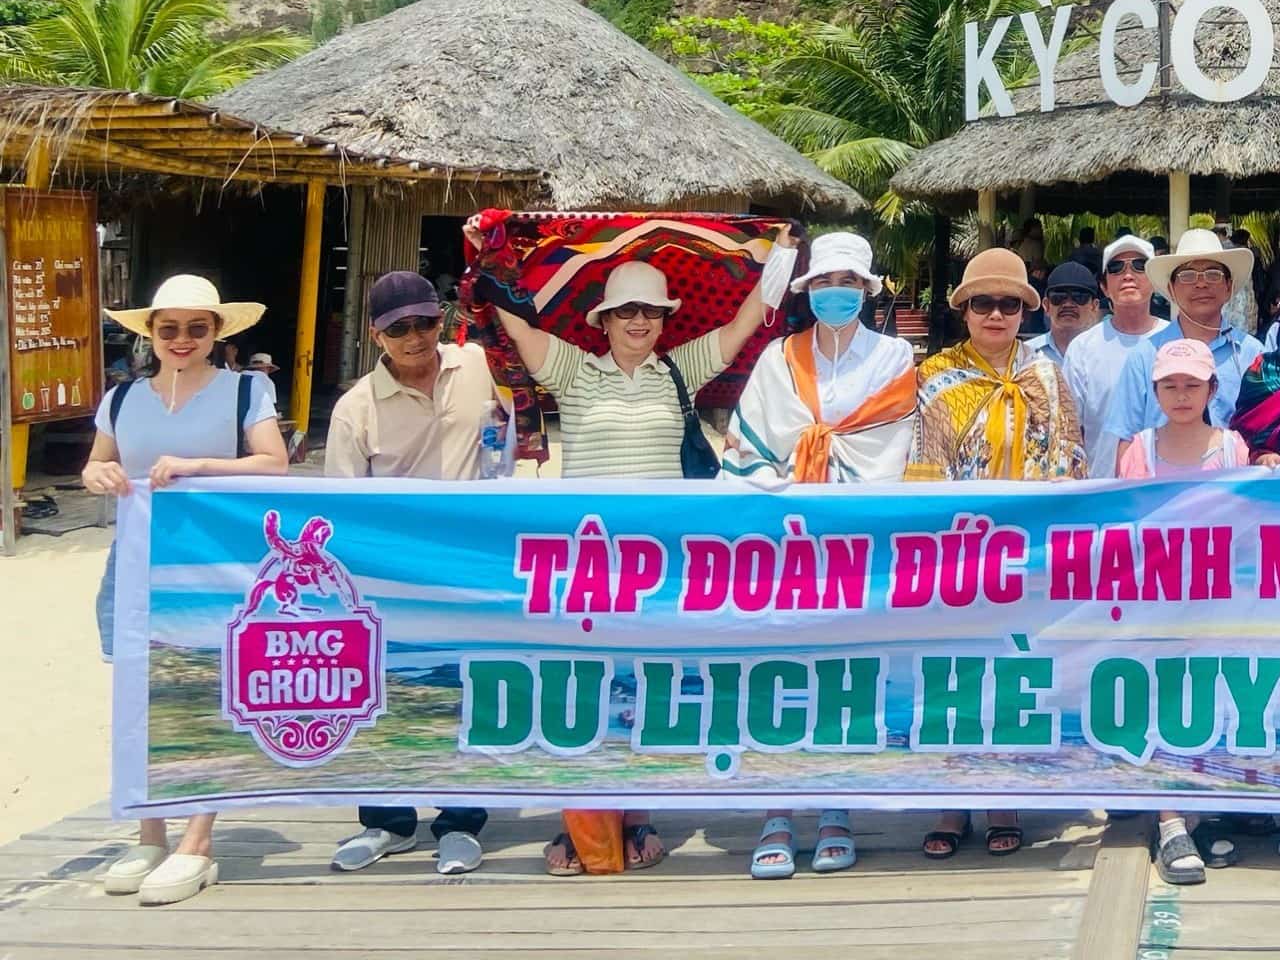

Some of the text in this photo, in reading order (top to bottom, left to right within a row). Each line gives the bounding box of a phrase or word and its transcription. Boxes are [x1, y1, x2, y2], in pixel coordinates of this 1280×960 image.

[519, 521, 663, 633] TẬP
[683, 520, 869, 612] ĐOÀN
[891, 518, 1026, 608] ĐỨC
[1049, 525, 1233, 622] HẠNH
[264, 629, 345, 658] BMG
[247, 667, 364, 705] GROUP
[468, 658, 608, 747] DU
[640, 656, 881, 772] LỊCH
[920, 633, 1054, 746] HÈ
